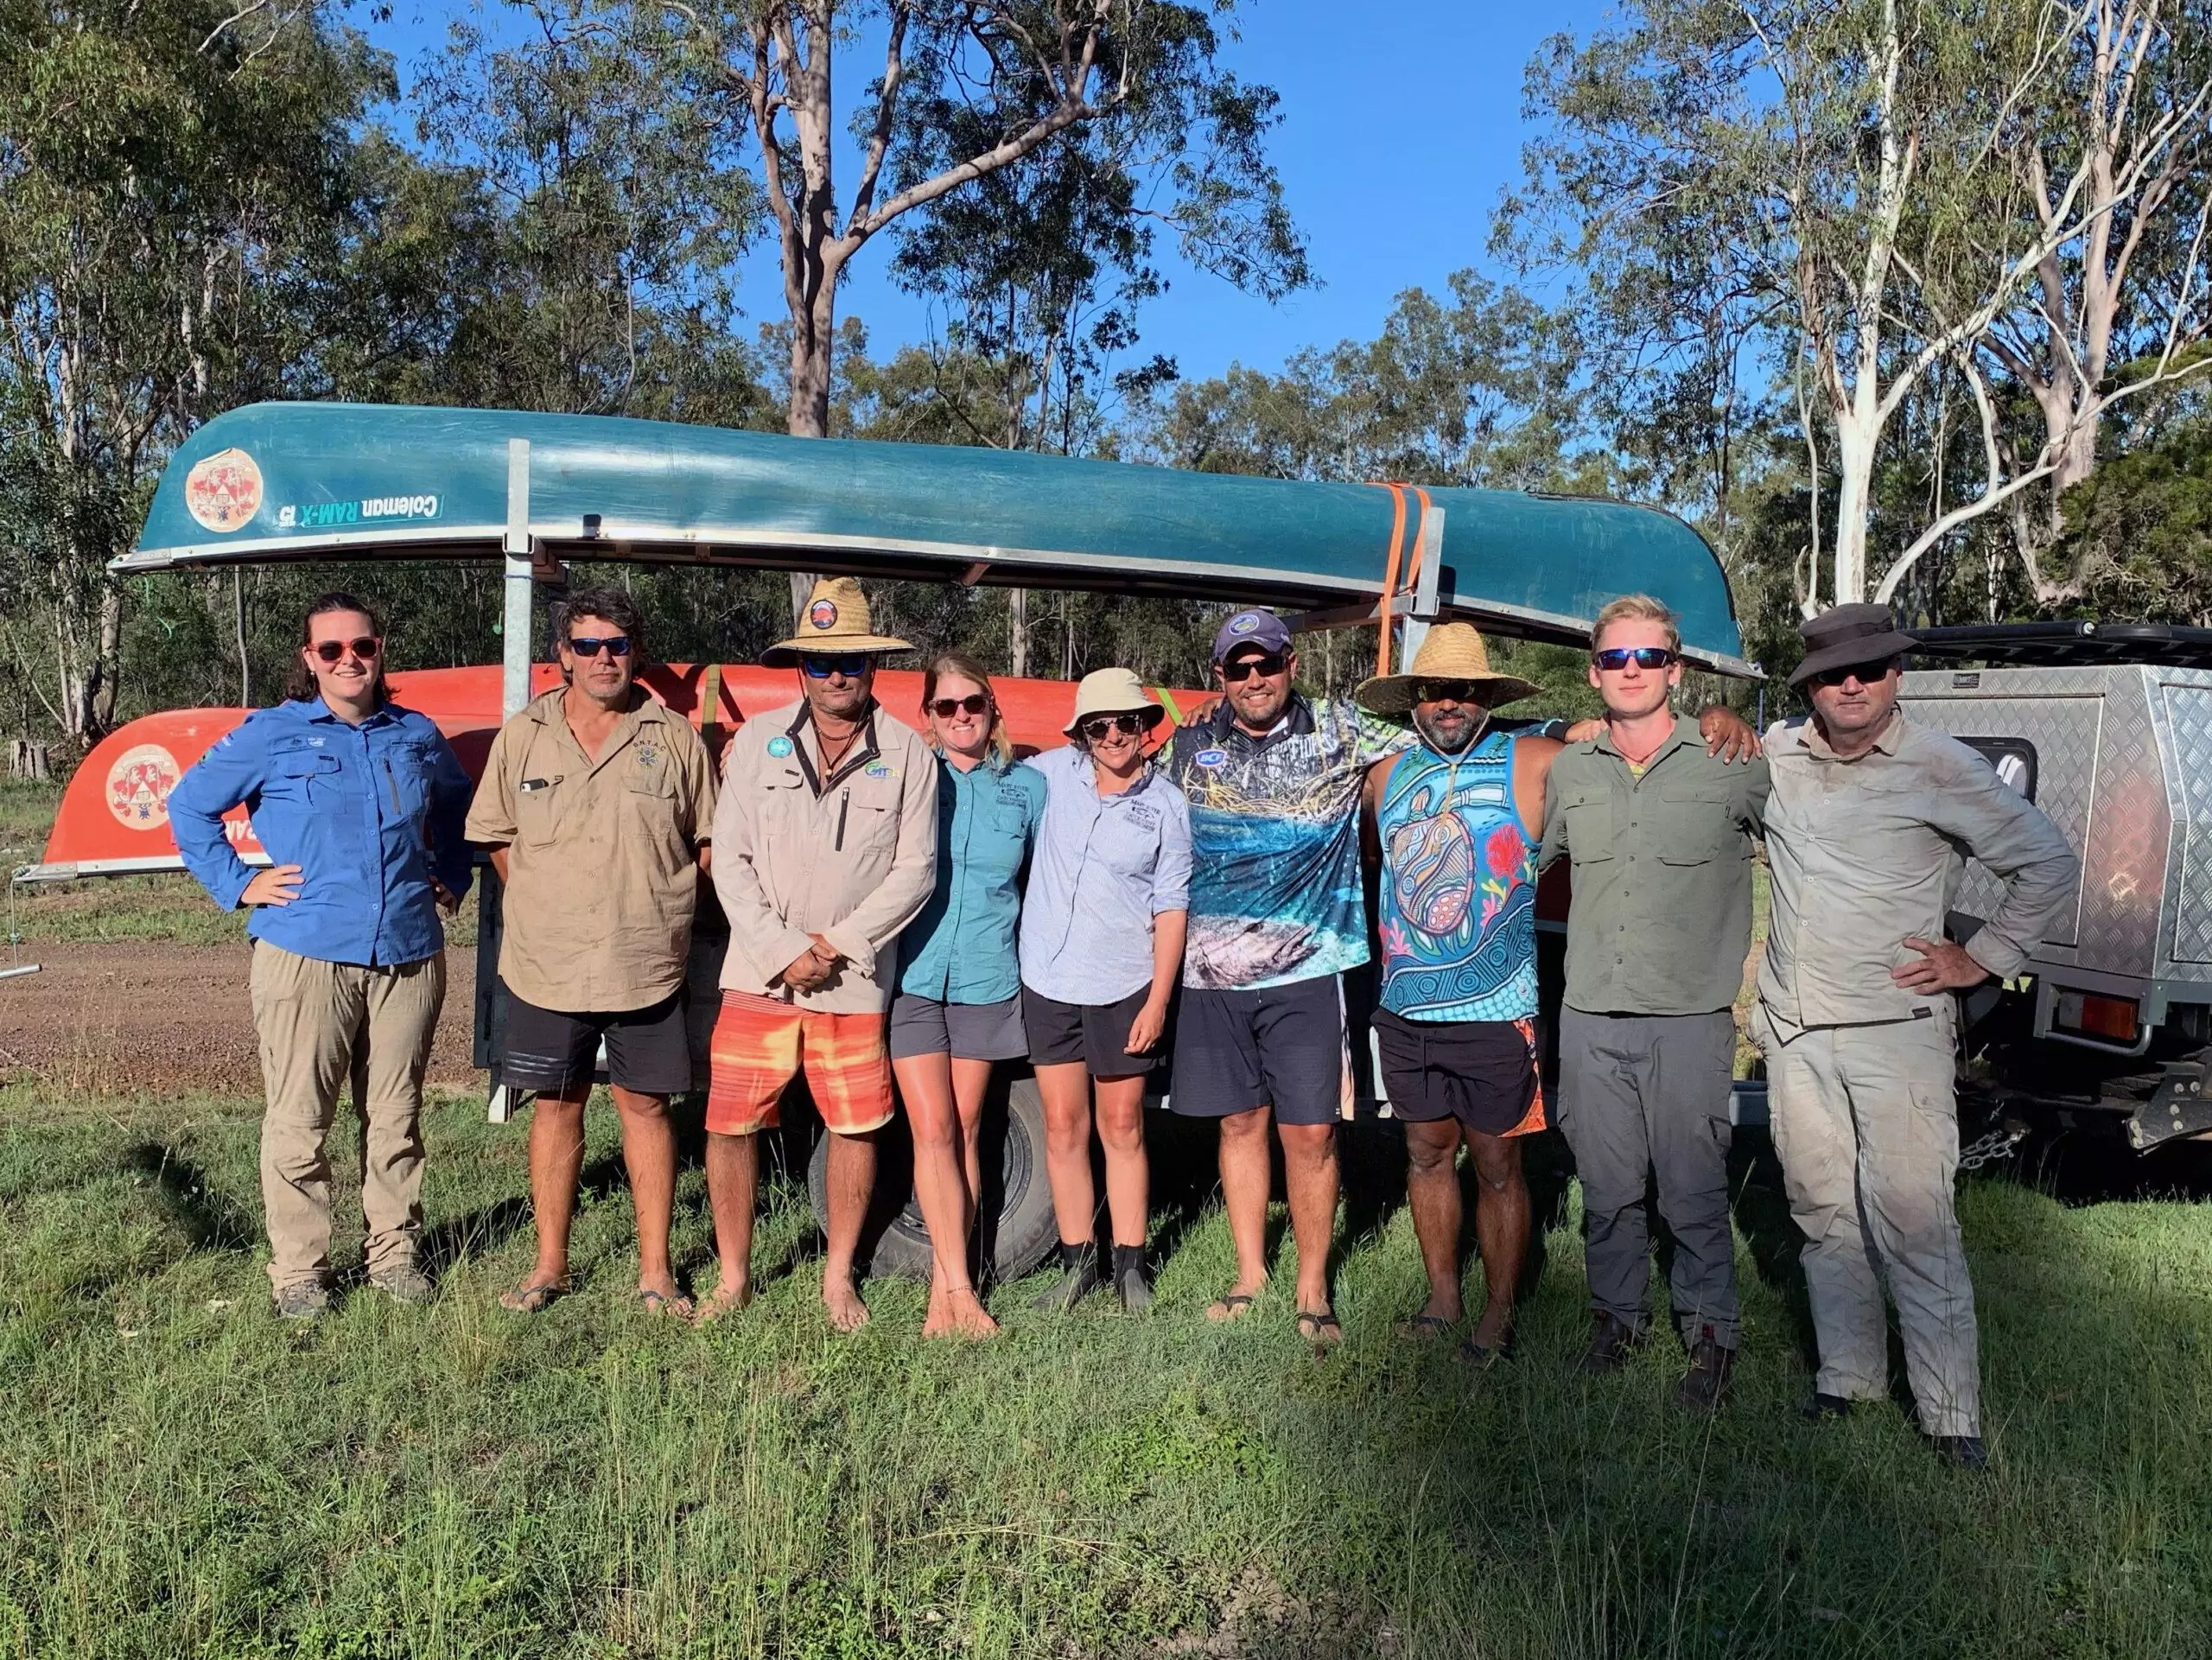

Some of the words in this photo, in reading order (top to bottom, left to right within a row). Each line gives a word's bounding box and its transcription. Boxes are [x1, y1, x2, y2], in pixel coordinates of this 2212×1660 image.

[279, 506, 296, 527] 15
[302, 501, 359, 525] RAM-X
[361, 495, 437, 518] Coleman
[1200, 754, 1224, 763] BCF
